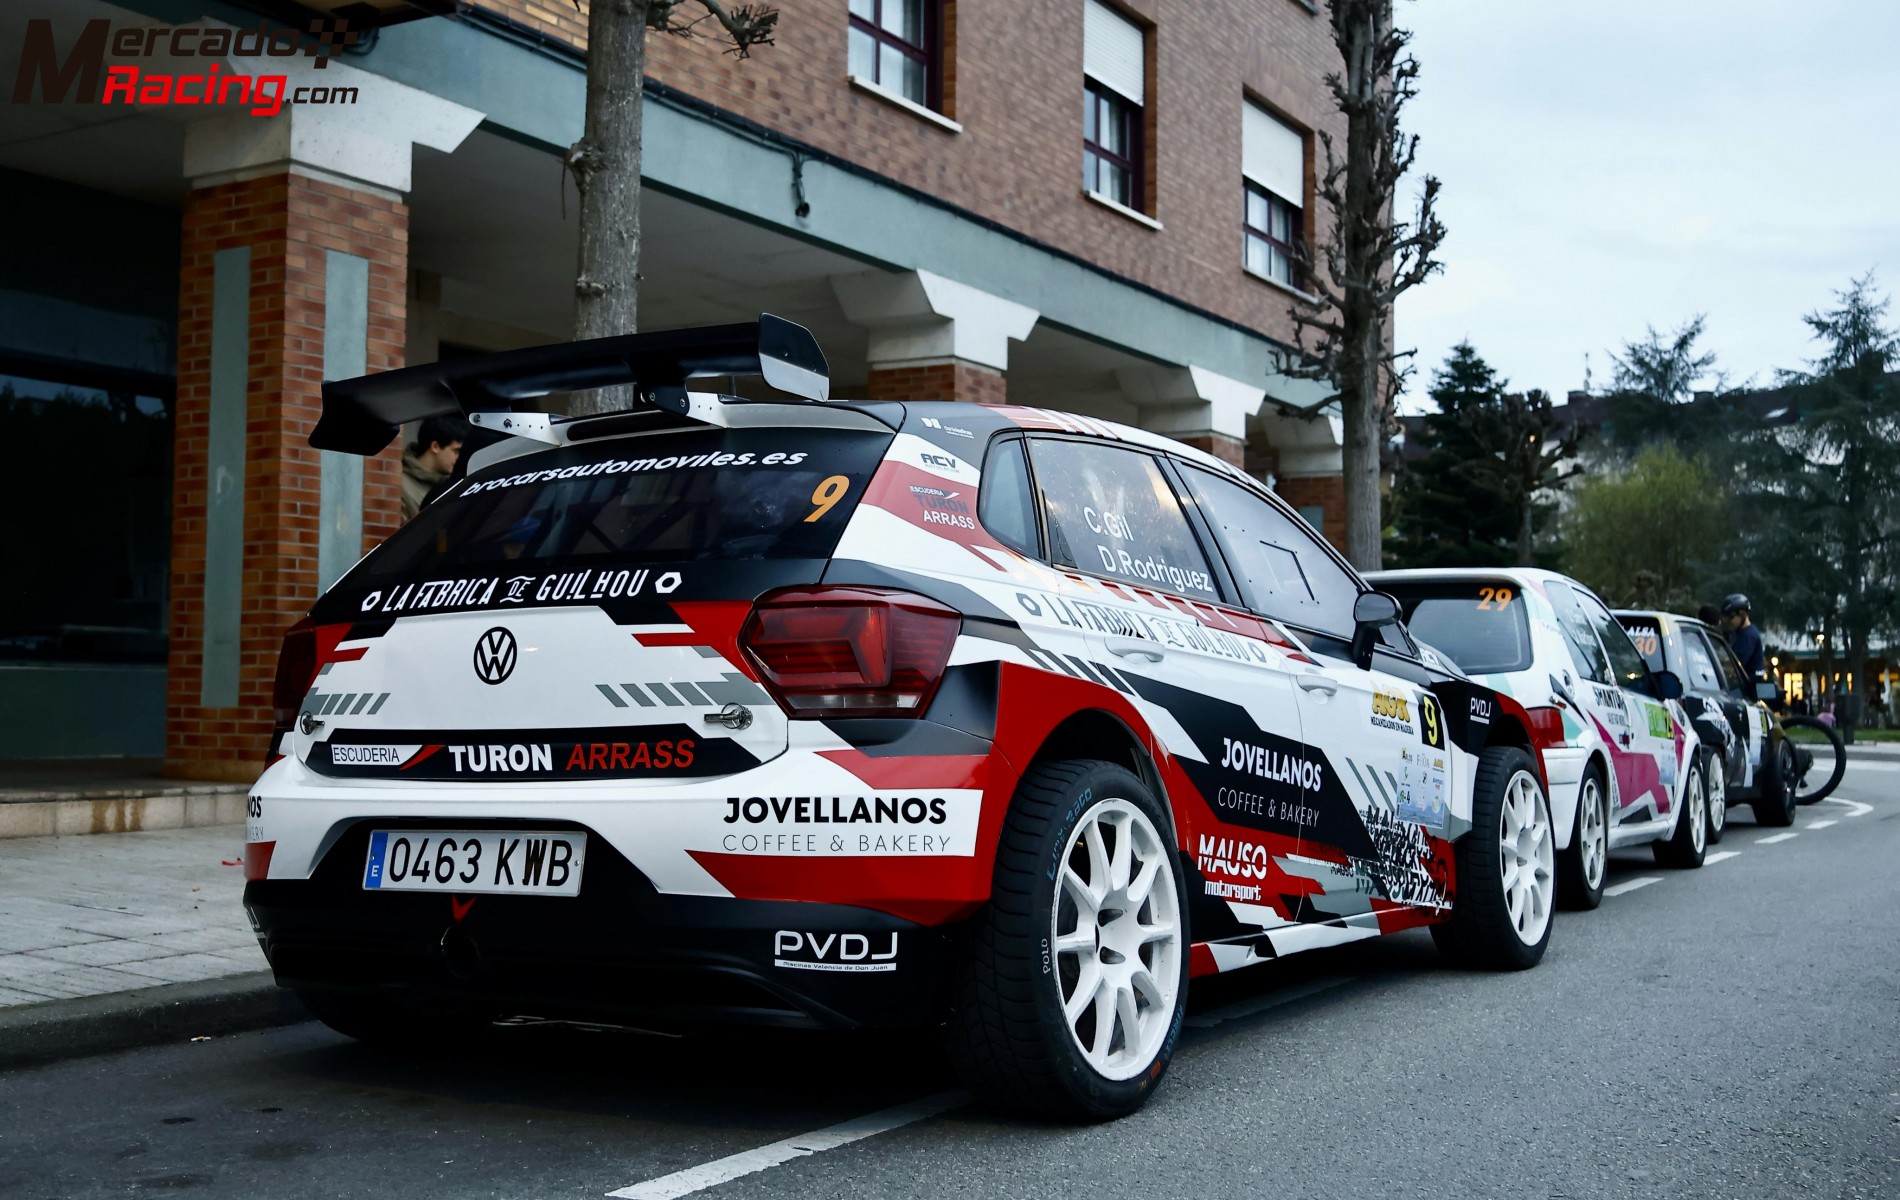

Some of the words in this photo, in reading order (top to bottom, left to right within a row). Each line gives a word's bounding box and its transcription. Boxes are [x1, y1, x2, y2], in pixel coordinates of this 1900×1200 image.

[459, 448, 809, 498] brocarsautomoviles.es
[803, 475, 851, 523] 9
[912, 494, 970, 515] TURON
[923, 509, 975, 530] ARRASS
[1083, 505, 1135, 542] C.Gil
[1096, 544, 1214, 593] D.Rodriguez
[382, 584, 411, 613] LA
[411, 577, 500, 609] FABRICA
[535, 568, 651, 602] GUILHOU
[1476, 587, 1513, 611] 29
[1040, 593, 1083, 629] LA
[1069, 599, 1157, 643] FABRICA
[1635, 637, 1657, 657] 30
[1423, 694, 1438, 746] 9
[1469, 696, 1492, 718] PVDJ
[332, 746, 400, 765] ESCUDERIA
[447, 743, 553, 773] TURON
[564, 739, 695, 771] ARRASS
[1221, 736, 1322, 792] JOVELLANOS
[722, 796, 947, 824] JOVELLANOS
[1218, 786, 1265, 823] COFFEE
[1268, 802, 1277, 819] &
[1279, 801, 1321, 828] BAKERY
[722, 833, 816, 852] COFFEE
[829, 834, 845, 852] &
[858, 834, 952, 853] BAKERY
[1197, 833, 1268, 880] MAUSO
[370, 863, 380, 878] E
[387, 837, 482, 883] 0463
[494, 838, 573, 888] KWB
[1204, 879, 1262, 901] motorsport
[774, 929, 898, 961] PVDJ
[1041, 938, 1051, 974] POLO
[782, 960, 812, 969] Piscinas
[813, 963, 843, 971] Valencia
